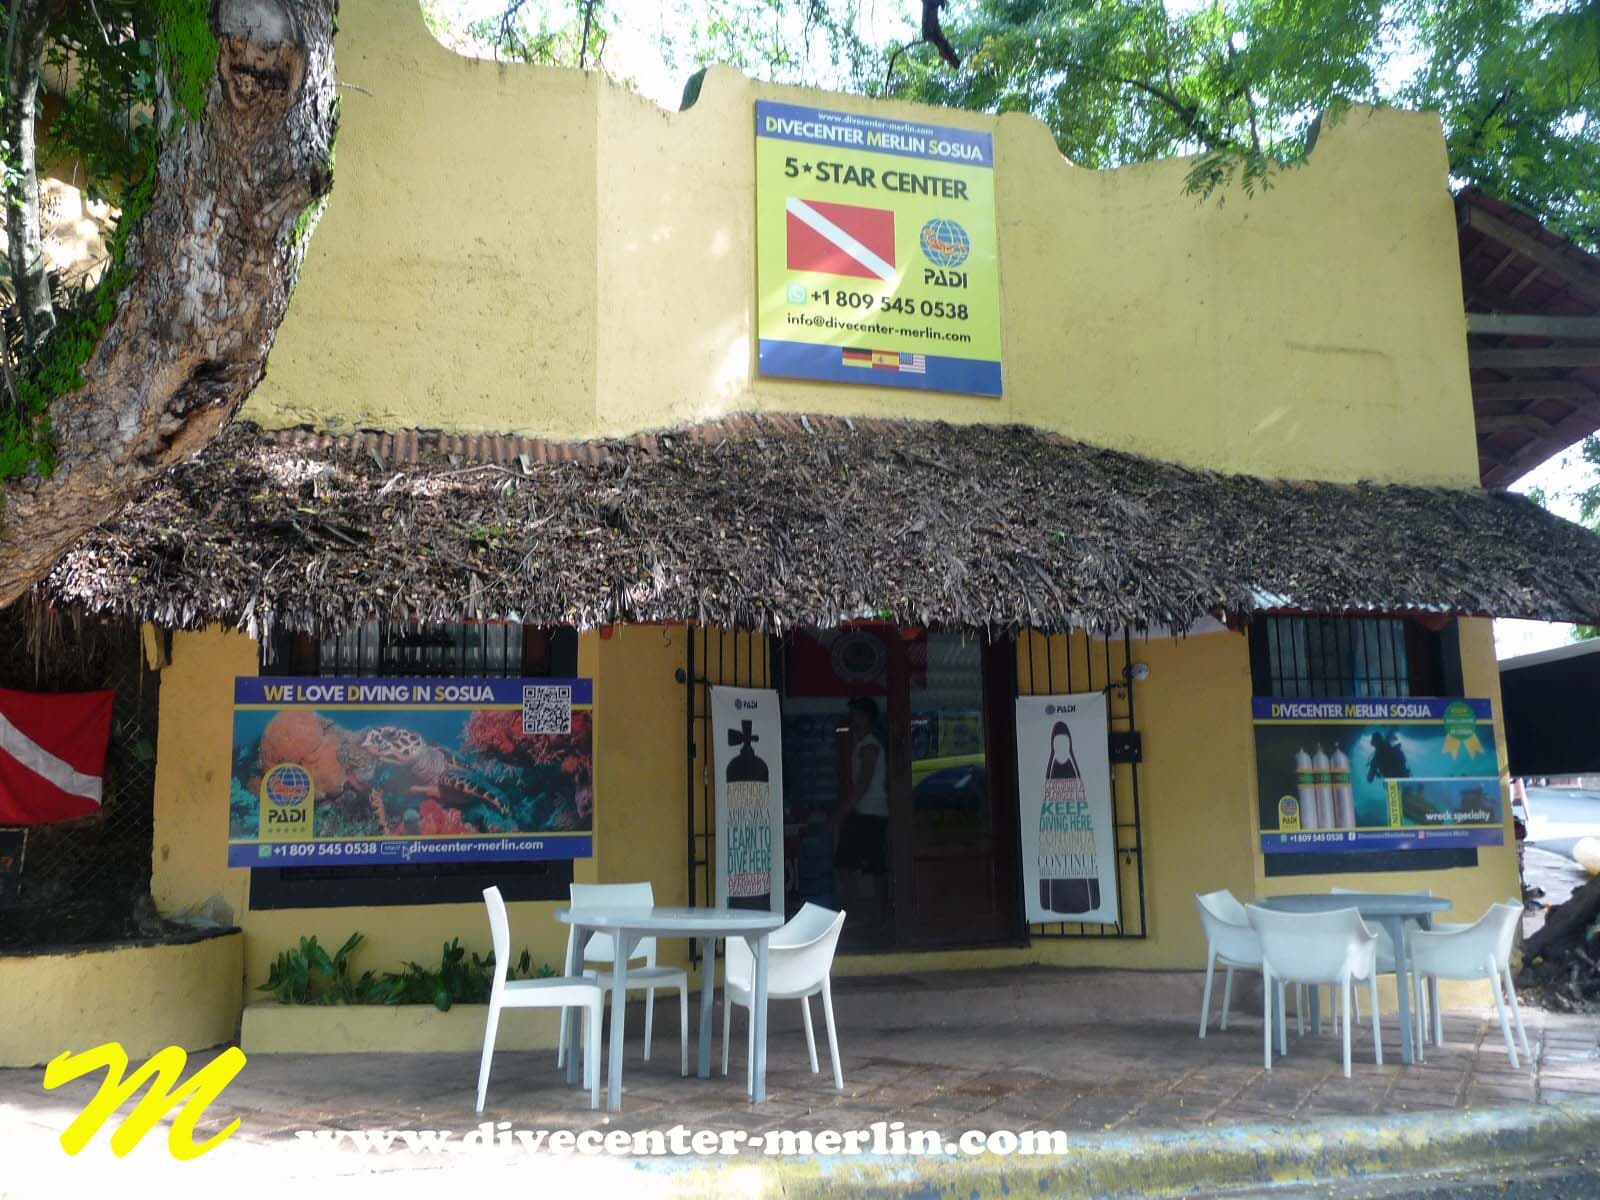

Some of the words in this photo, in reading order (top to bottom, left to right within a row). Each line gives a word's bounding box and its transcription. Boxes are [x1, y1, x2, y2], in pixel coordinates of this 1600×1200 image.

[818, 112, 934, 136] www.divecenter-merlin.com
[765, 116, 864, 145] DIVECENTER
[866, 131, 925, 153] MERLIN
[928, 140, 984, 161] SOSUA
[815, 161, 876, 189] STAR
[881, 170, 969, 201] CENTER
[924, 268, 968, 289] PADI
[811, 289, 830, 305] +1
[836, 292, 874, 310] 809
[880, 296, 915, 315] 545
[920, 300, 969, 321] 0538
[787, 312, 972, 344] info@divecenter-merlin.com
[263, 684, 294, 702] WE
[297, 684, 344, 702] LOVE
[347, 685, 409, 702] DIVING
[412, 685, 431, 702] IN
[434, 685, 495, 702] SOSUA
[1271, 703, 1343, 719] DIVECENTER
[1345, 703, 1389, 719] MERLIN
[1391, 703, 1432, 718] SOSUA
[268, 809, 307, 824] PADI
[1040, 801, 1088, 816] KEEP
[1039, 815, 1068, 832] DIVING
[1070, 815, 1094, 832] HERE
[274, 844, 287, 856] +1
[290, 843, 315, 856] 809
[318, 843, 342, 855] 545
[345, 842, 377, 855] 0538
[409, 839, 544, 854] divecenter-merlin.com
[727, 826, 757, 851] LEARN
[759, 826, 771, 851] TO
[727, 850, 747, 875] DIVE
[749, 849, 772, 873] HERE
